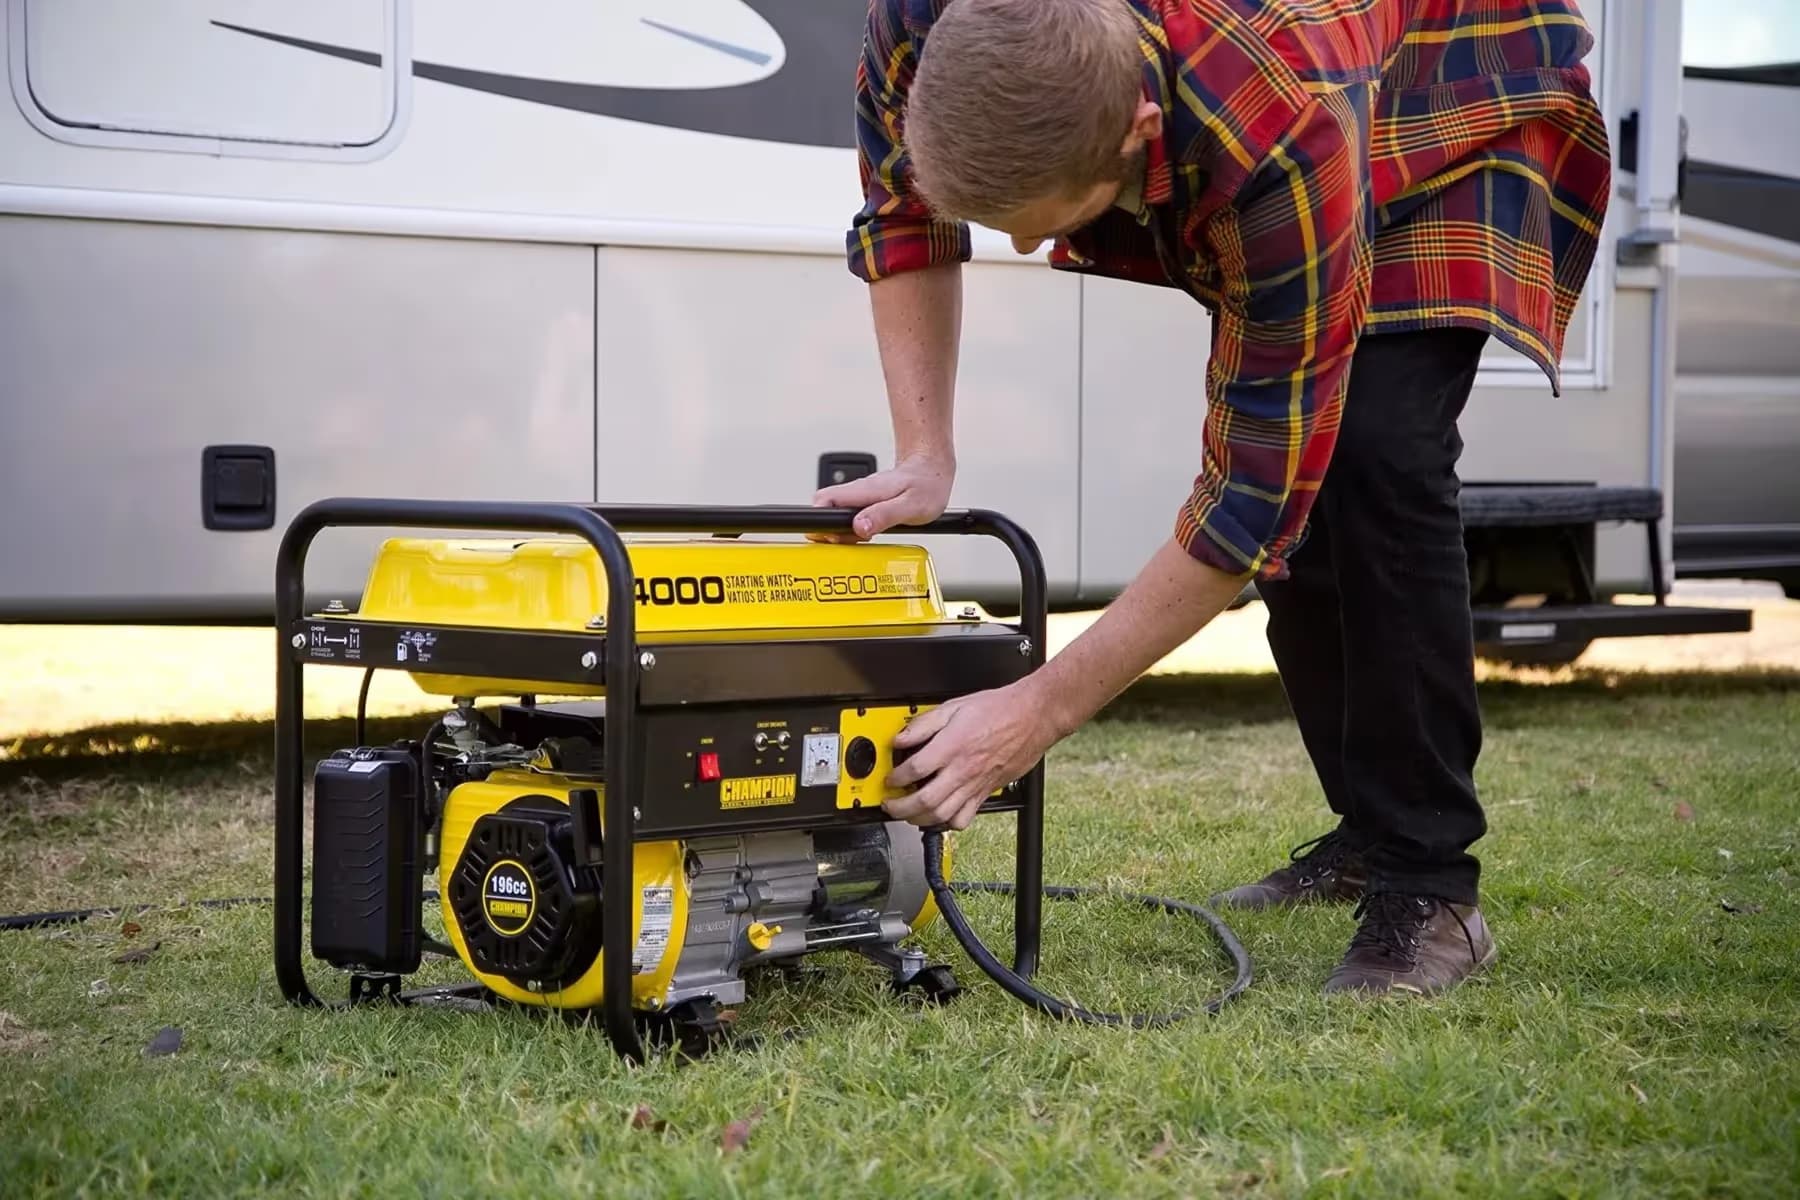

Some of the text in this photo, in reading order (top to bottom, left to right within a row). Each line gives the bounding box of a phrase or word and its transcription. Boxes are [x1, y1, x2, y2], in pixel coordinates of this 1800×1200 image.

[635, 576, 725, 606] 4000
[726, 575, 764, 588] STARTING
[766, 574, 793, 587] WATTS
[818, 575, 877, 595] 3500
[726, 590, 755, 603] VATIOS
[757, 590, 768, 602] DE
[770, 588, 812, 602] ARRANQUE
[722, 776, 795, 802] CHAMPION
[492, 876, 527, 895] 196cc
[491, 901, 527, 914] CHAMPION
